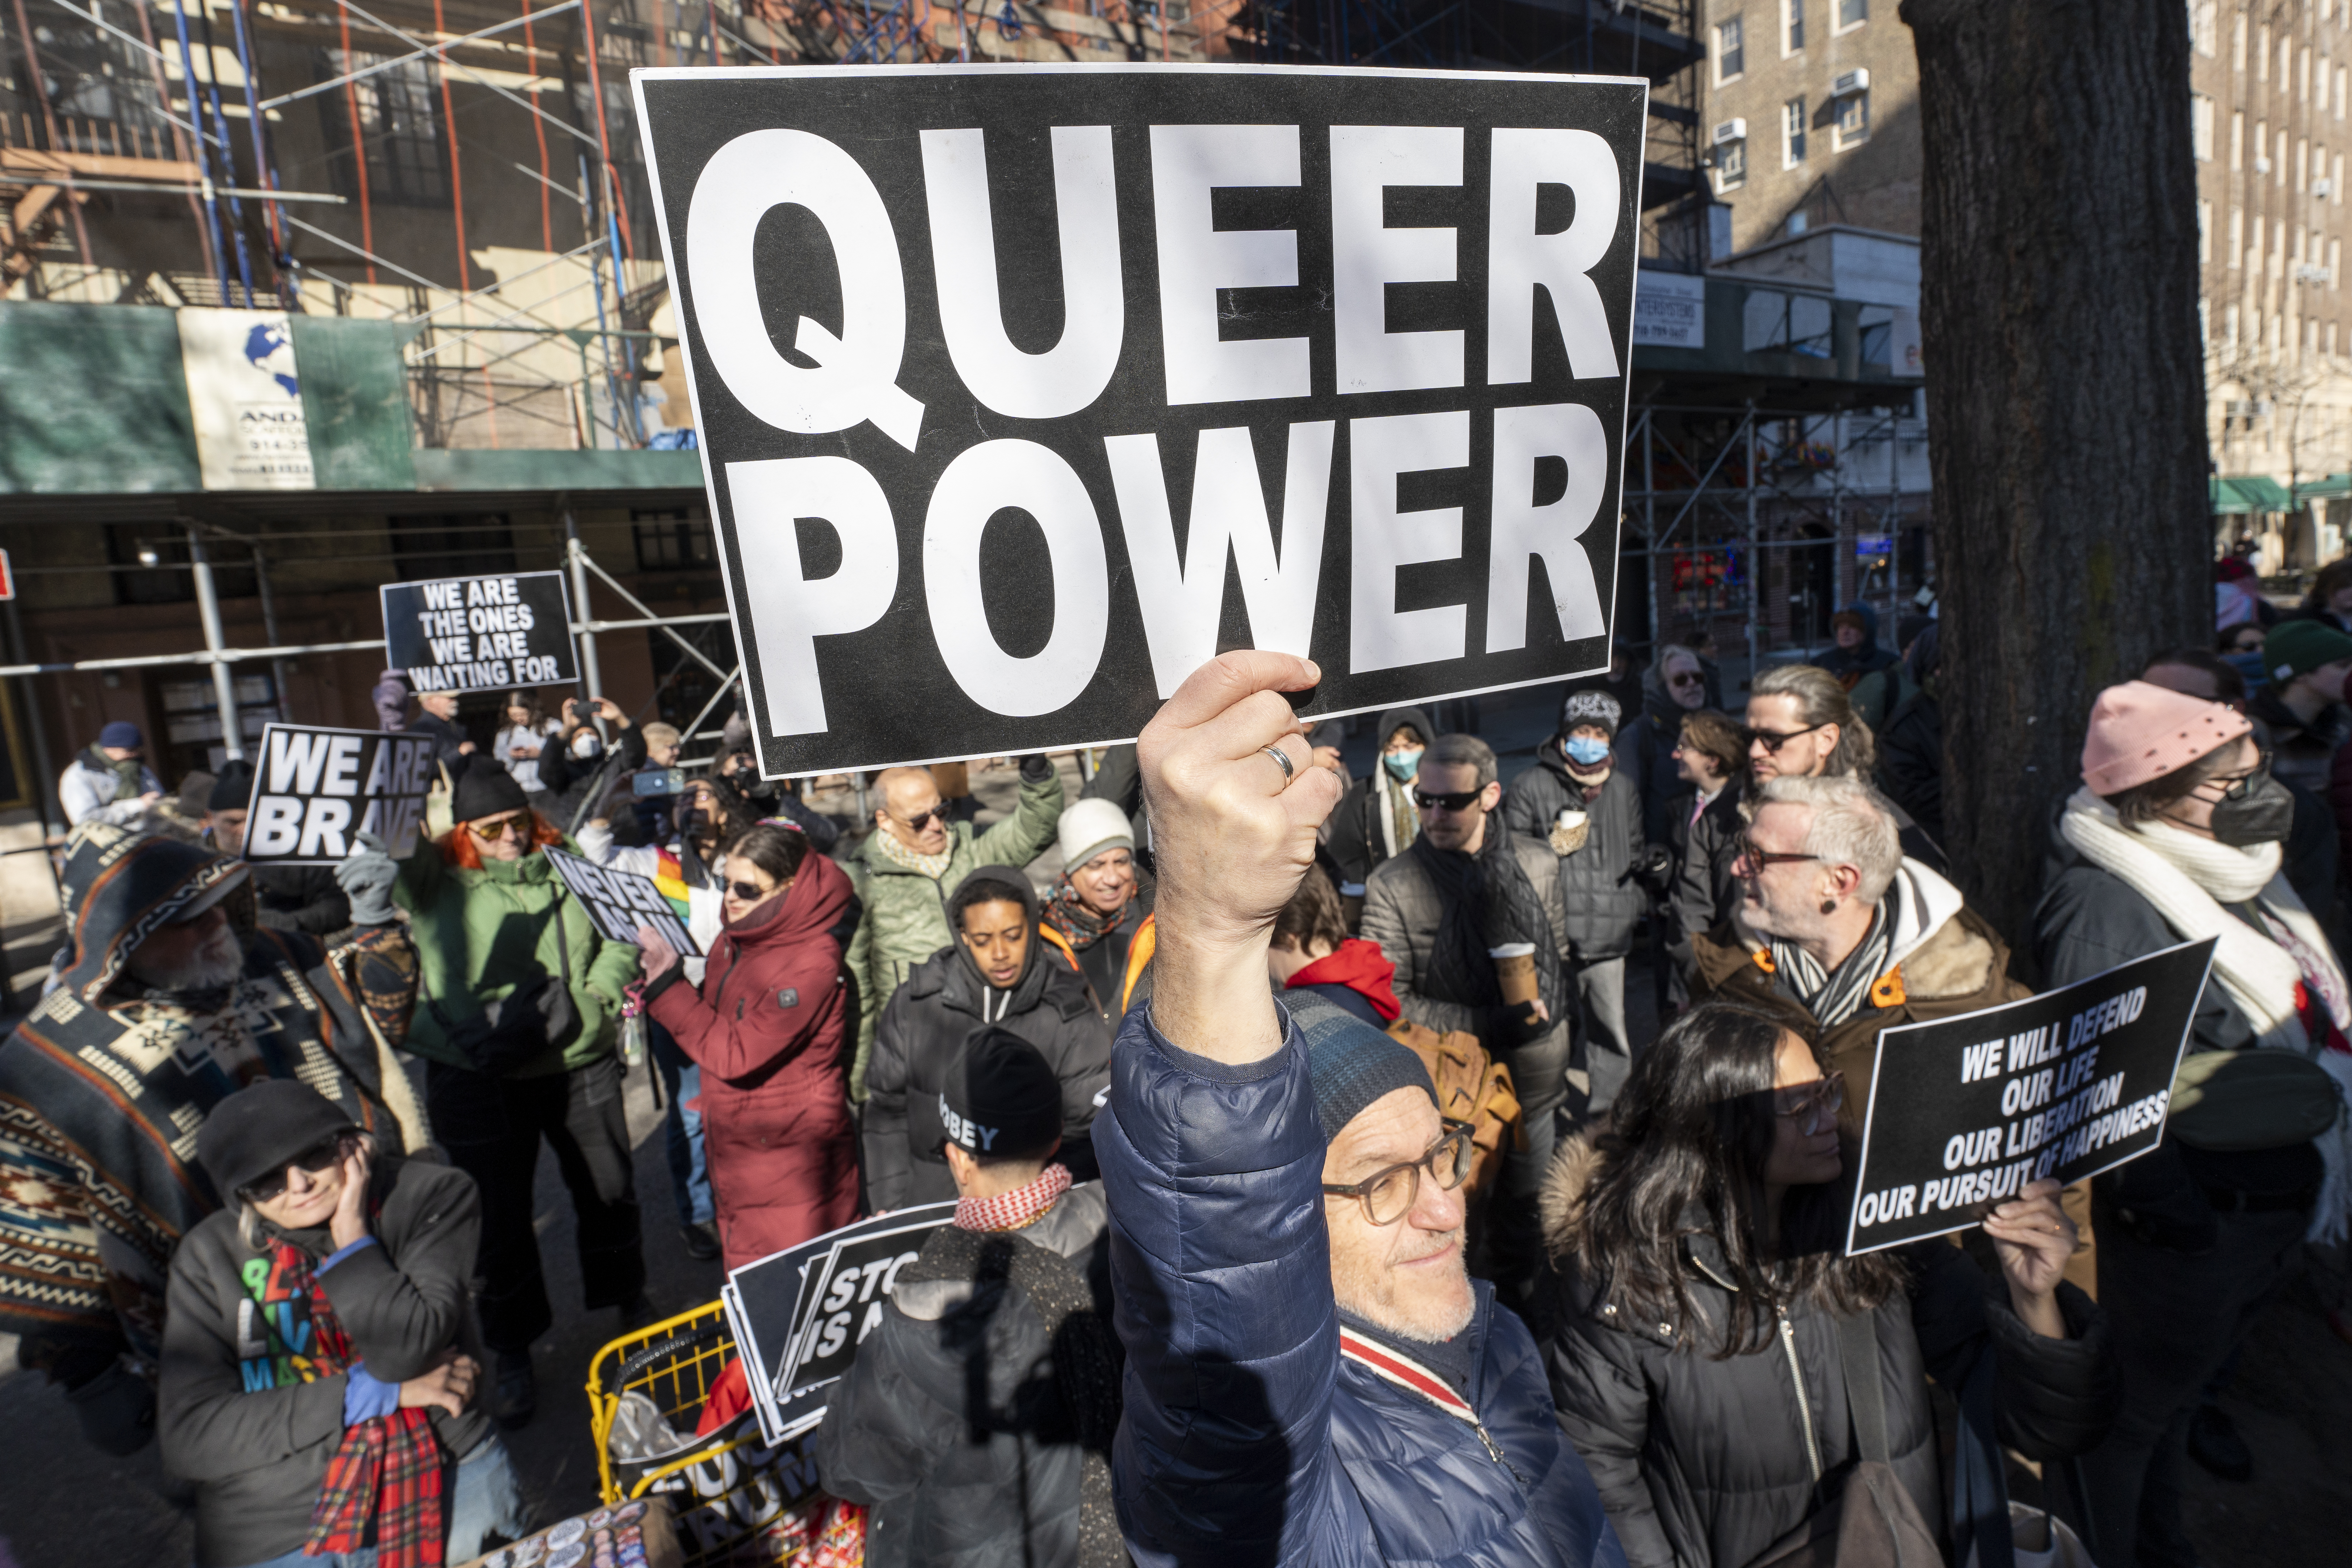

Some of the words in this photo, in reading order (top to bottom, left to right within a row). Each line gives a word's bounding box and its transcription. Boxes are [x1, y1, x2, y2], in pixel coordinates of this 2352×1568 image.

[686, 124, 1620, 453] QUEER
[239, 411, 305, 422] AND
[423, 582, 463, 611] WE
[467, 578, 520, 607] ARE
[724, 403, 1608, 737] POWER
[418, 608, 469, 639] THE
[469, 603, 535, 634] ONES
[430, 636, 473, 664] WE
[477, 631, 529, 661] ARE
[408, 660, 510, 692] WAITING
[512, 655, 559, 684] FOR
[269, 731, 363, 796] WE
[364, 738, 430, 796] ARE
[551, 853, 673, 914] NEVER
[1962, 1039, 2003, 1083] WE
[2008, 1022, 2061, 1072] WILL
[2067, 986, 2147, 1050] DEFEND
[2002, 1072, 2054, 1116] OUR
[2056, 1046, 2099, 1097] LIFE
[1944, 1127, 2002, 1170] OUR
[2006, 1071, 2124, 1158] LIBERATION
[1858, 1185, 1916, 1227] OUR
[1920, 1157, 2033, 1214] PURSUIT
[2035, 1145, 2062, 1180] OF
[2060, 1089, 2169, 1167] HAPPINESS
[238, 1298, 321, 1358] LIV
[800, 1311, 852, 1365] IS
